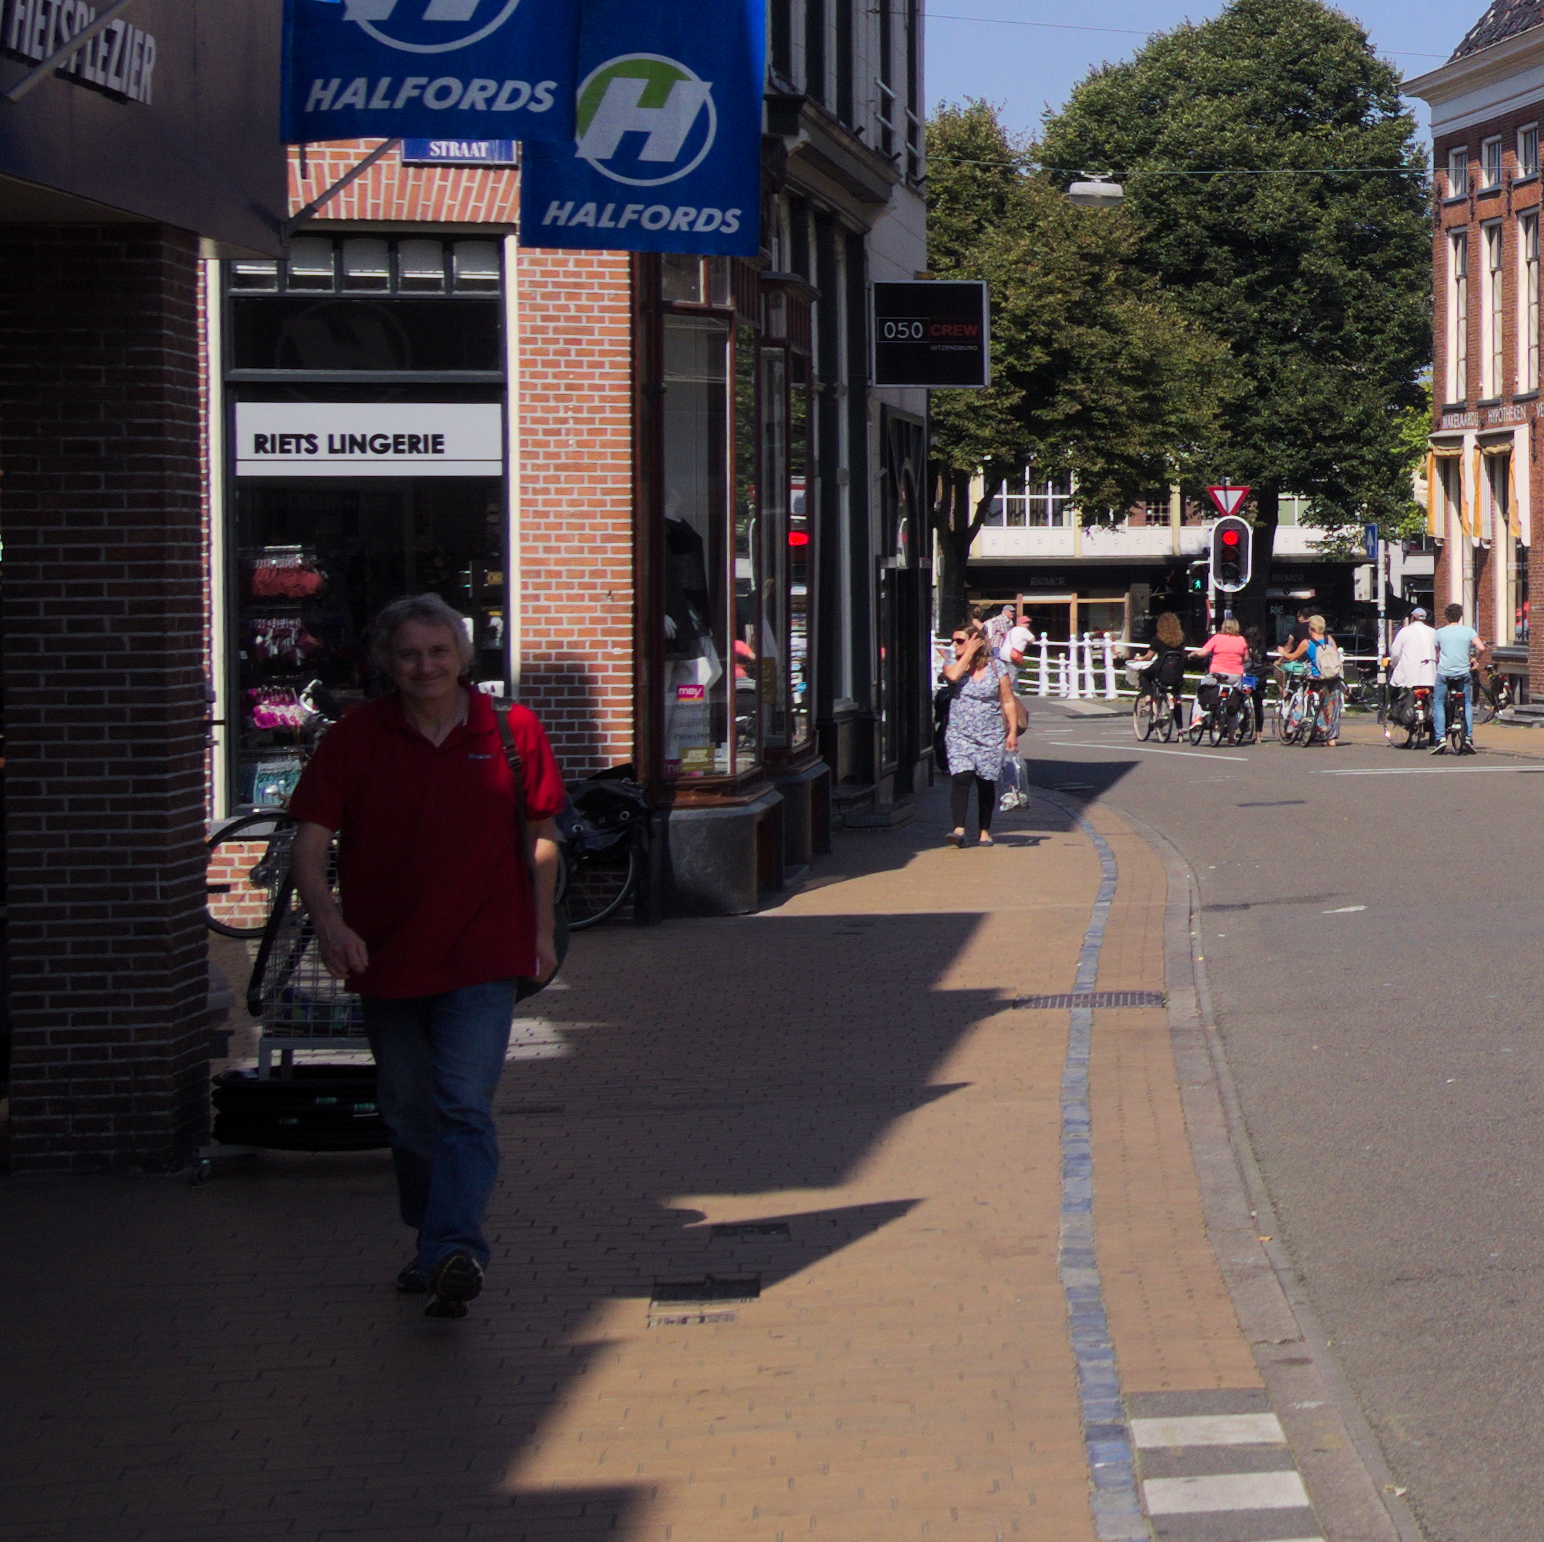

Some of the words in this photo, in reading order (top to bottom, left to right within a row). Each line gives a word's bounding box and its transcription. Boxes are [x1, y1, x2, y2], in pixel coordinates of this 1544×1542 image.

[304, 76, 557, 112] HALFORDS
[429, 140, 488, 158] STRAAT
[542, 201, 742, 234] HALFORDS
[884, 321, 923, 338] 050
[930, 324, 978, 336] CREW
[1488, 405, 1526, 423] HYPOTHEKEN
[254, 433, 318, 454] RIETS
[327, 433, 445, 454] LINGERIE
[678, 687, 703, 698] mey
